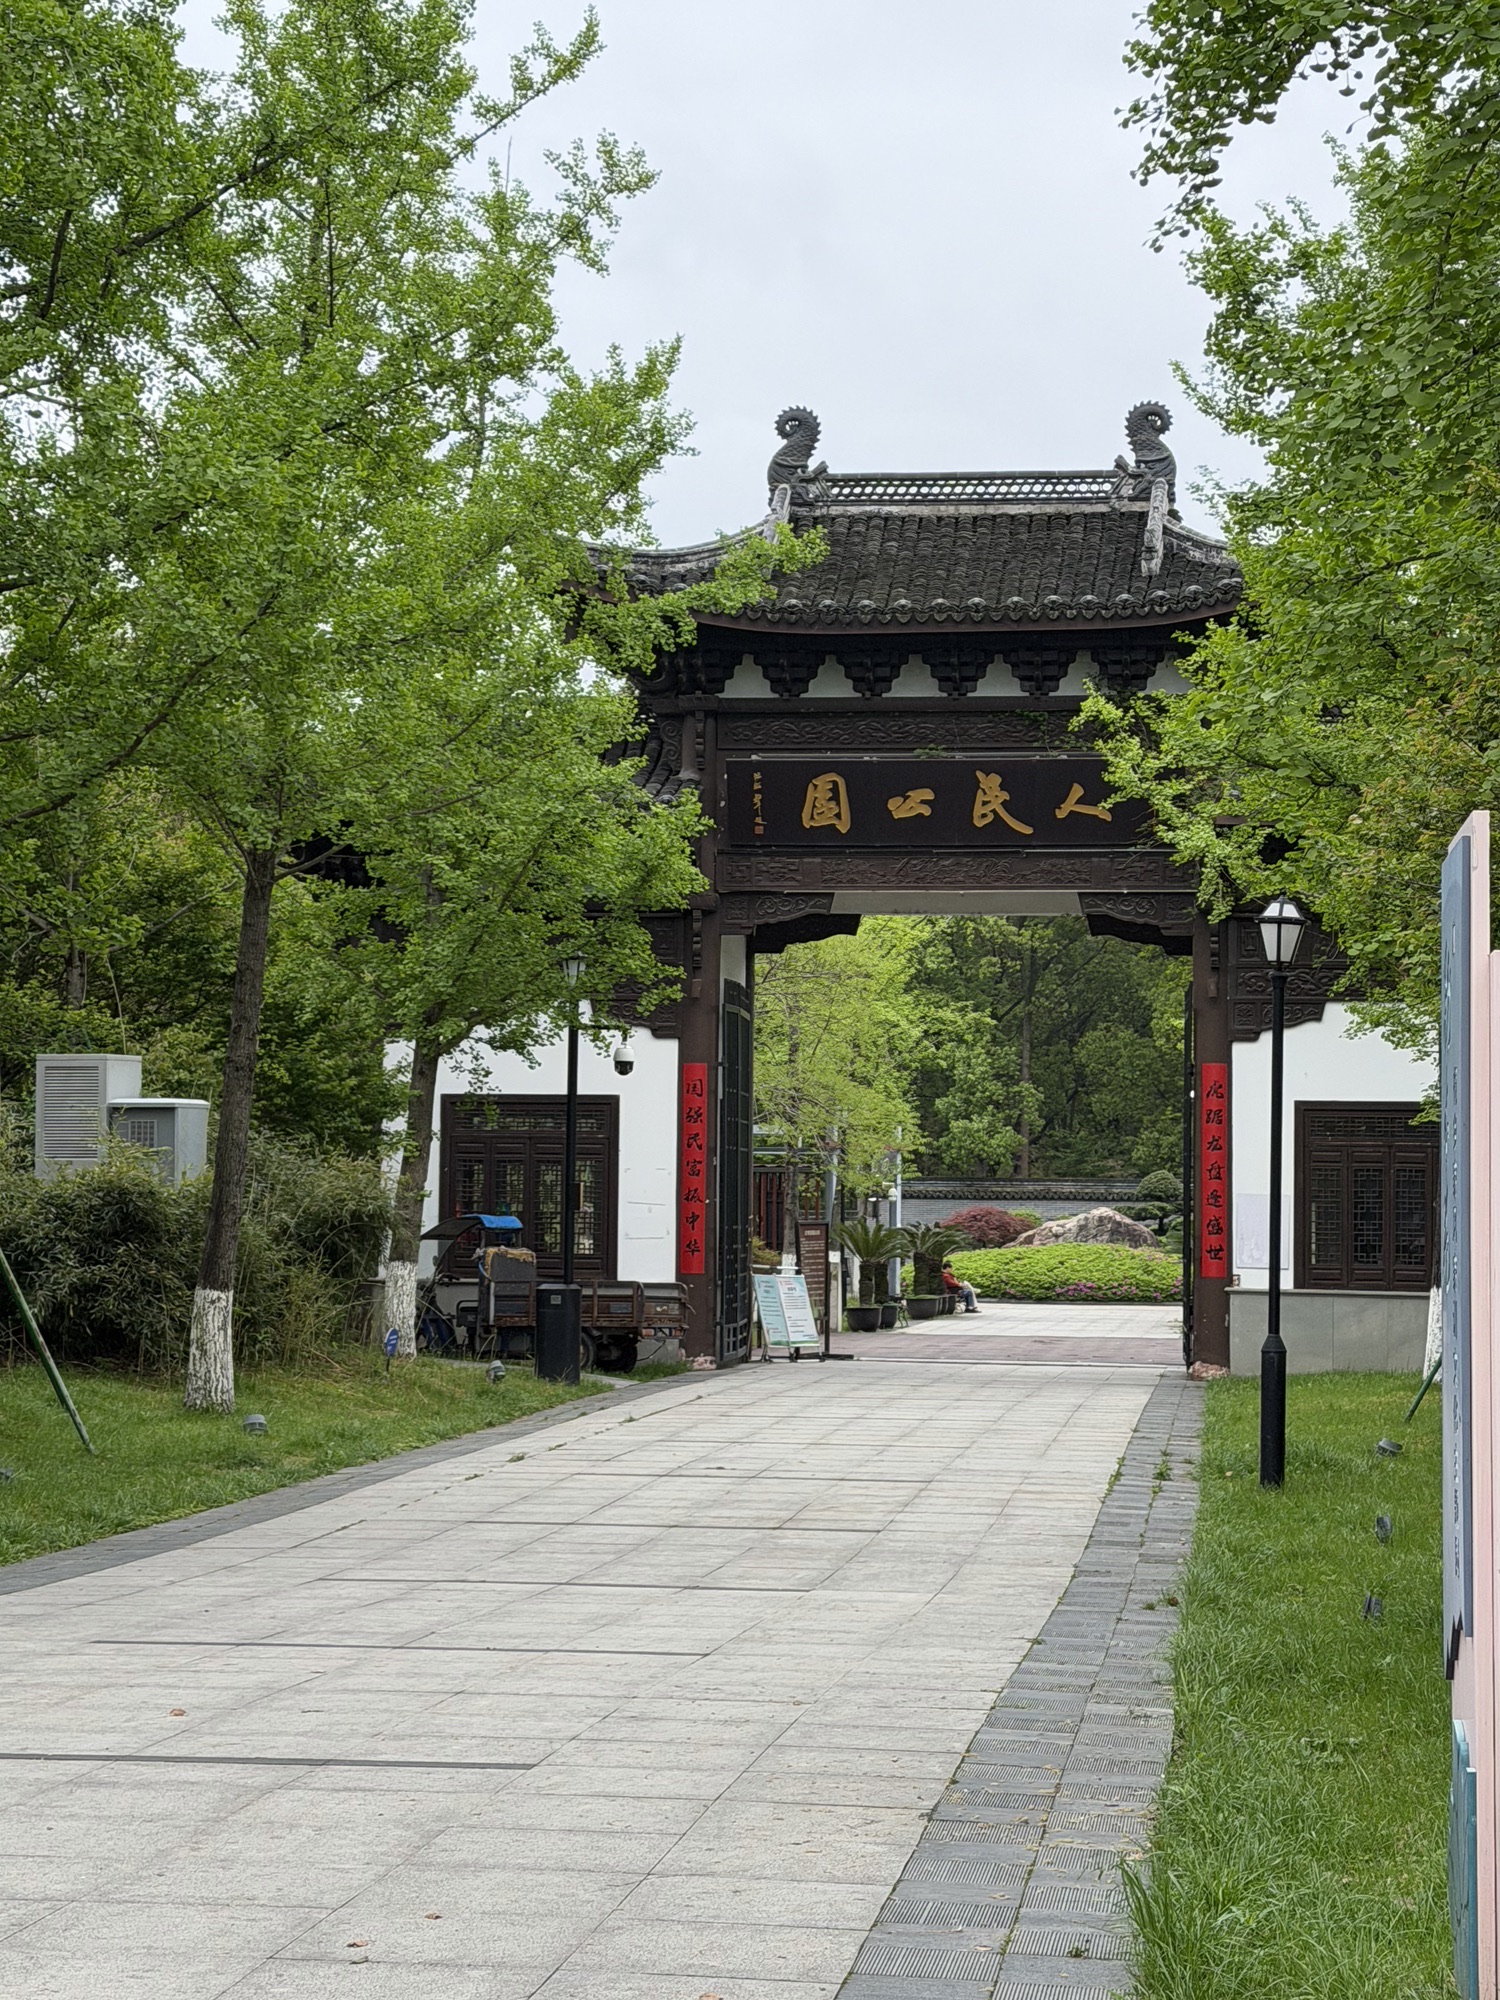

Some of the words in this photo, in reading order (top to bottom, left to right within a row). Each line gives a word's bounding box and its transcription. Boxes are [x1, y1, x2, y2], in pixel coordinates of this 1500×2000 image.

[684, 1079, 704, 1257] 国强民富振中华
